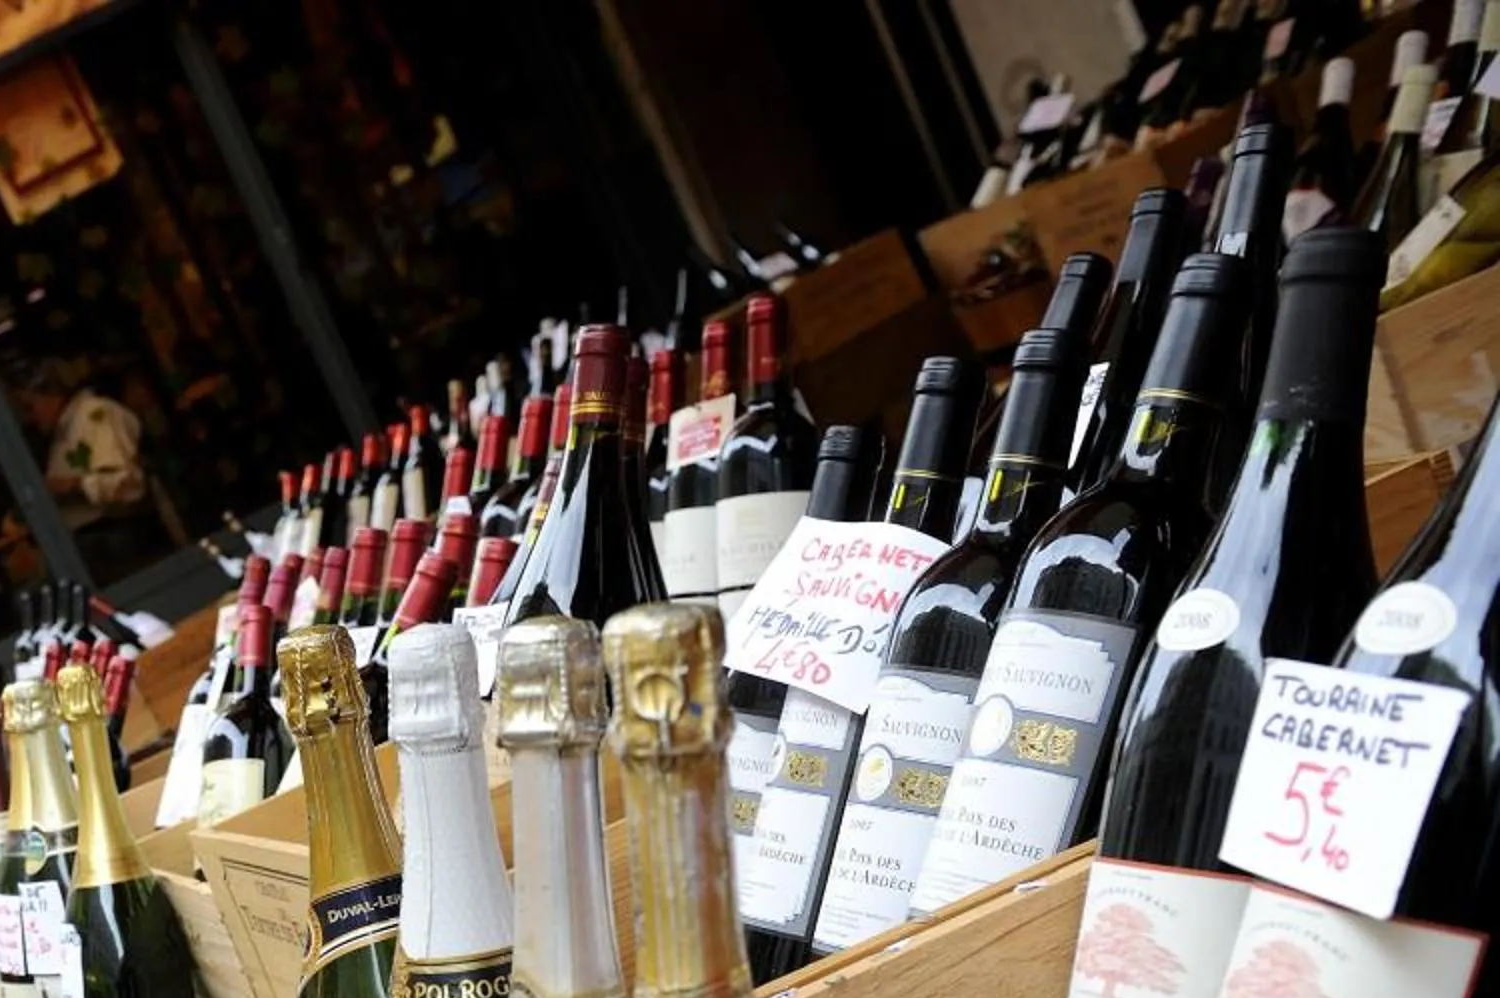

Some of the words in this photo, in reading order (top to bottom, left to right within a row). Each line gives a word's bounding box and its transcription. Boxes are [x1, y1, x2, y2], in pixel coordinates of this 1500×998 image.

[796, 572, 900, 615] SAUVIGN
[1273, 674, 1424, 722] TOURAINE
[1261, 713, 1432, 768] CABERNET
[326, 893, 402, 924] DUVAL-LE
